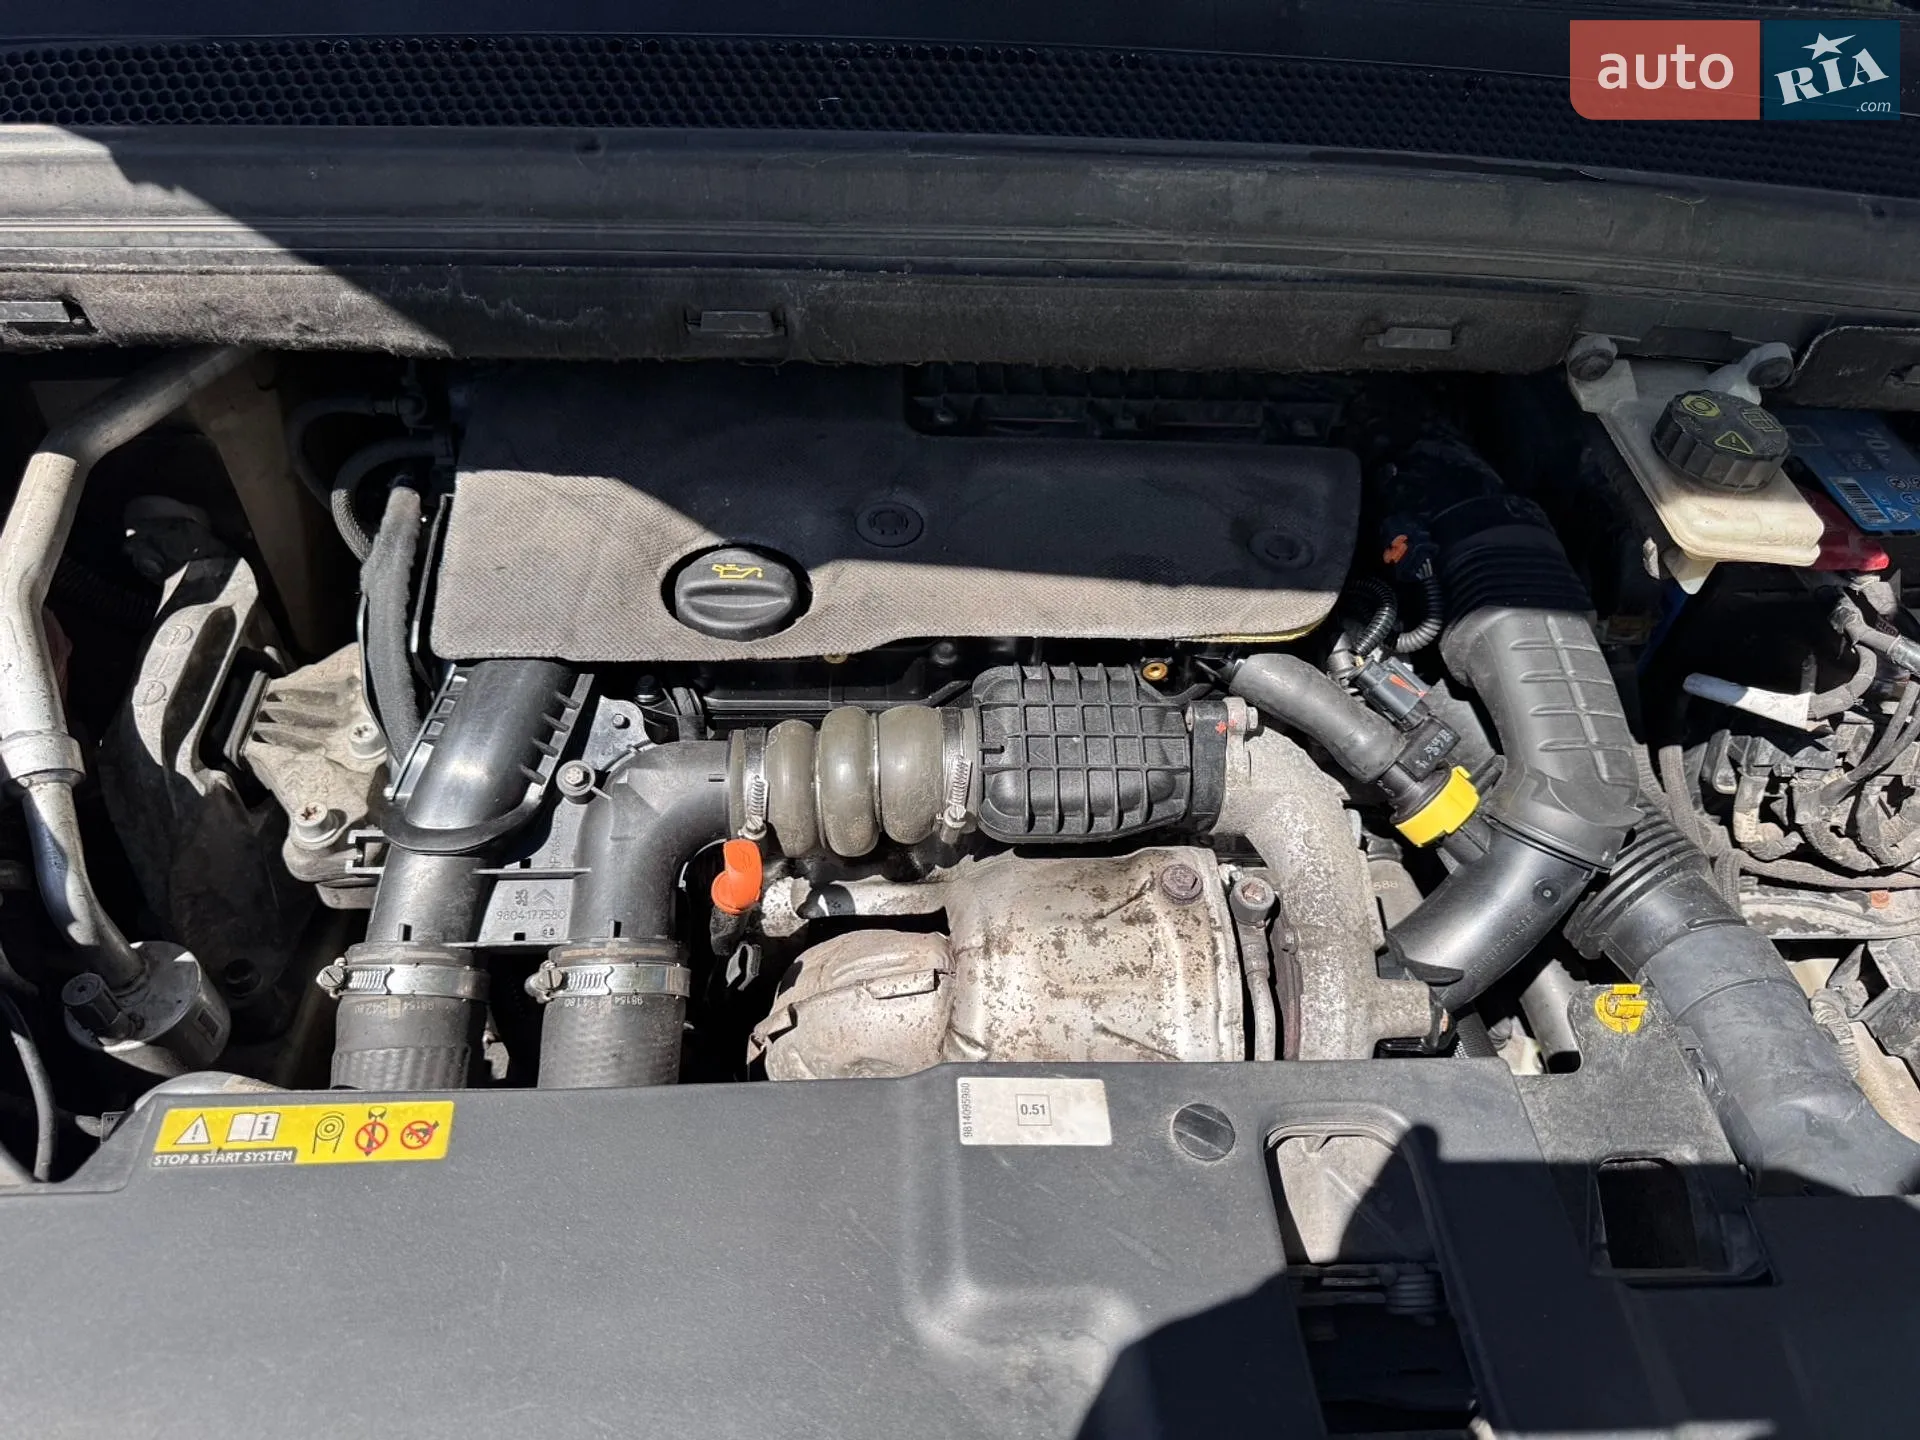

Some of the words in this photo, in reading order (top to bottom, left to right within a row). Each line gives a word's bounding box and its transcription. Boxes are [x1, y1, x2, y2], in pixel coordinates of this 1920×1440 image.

[1020, 1103, 1046, 1116] 0.51
[152, 1154, 189, 1166] STOP
[189, 1154, 200, 1165] &
[201, 1152, 243, 1164] START
[243, 1150, 293, 1162] SYSTEM
